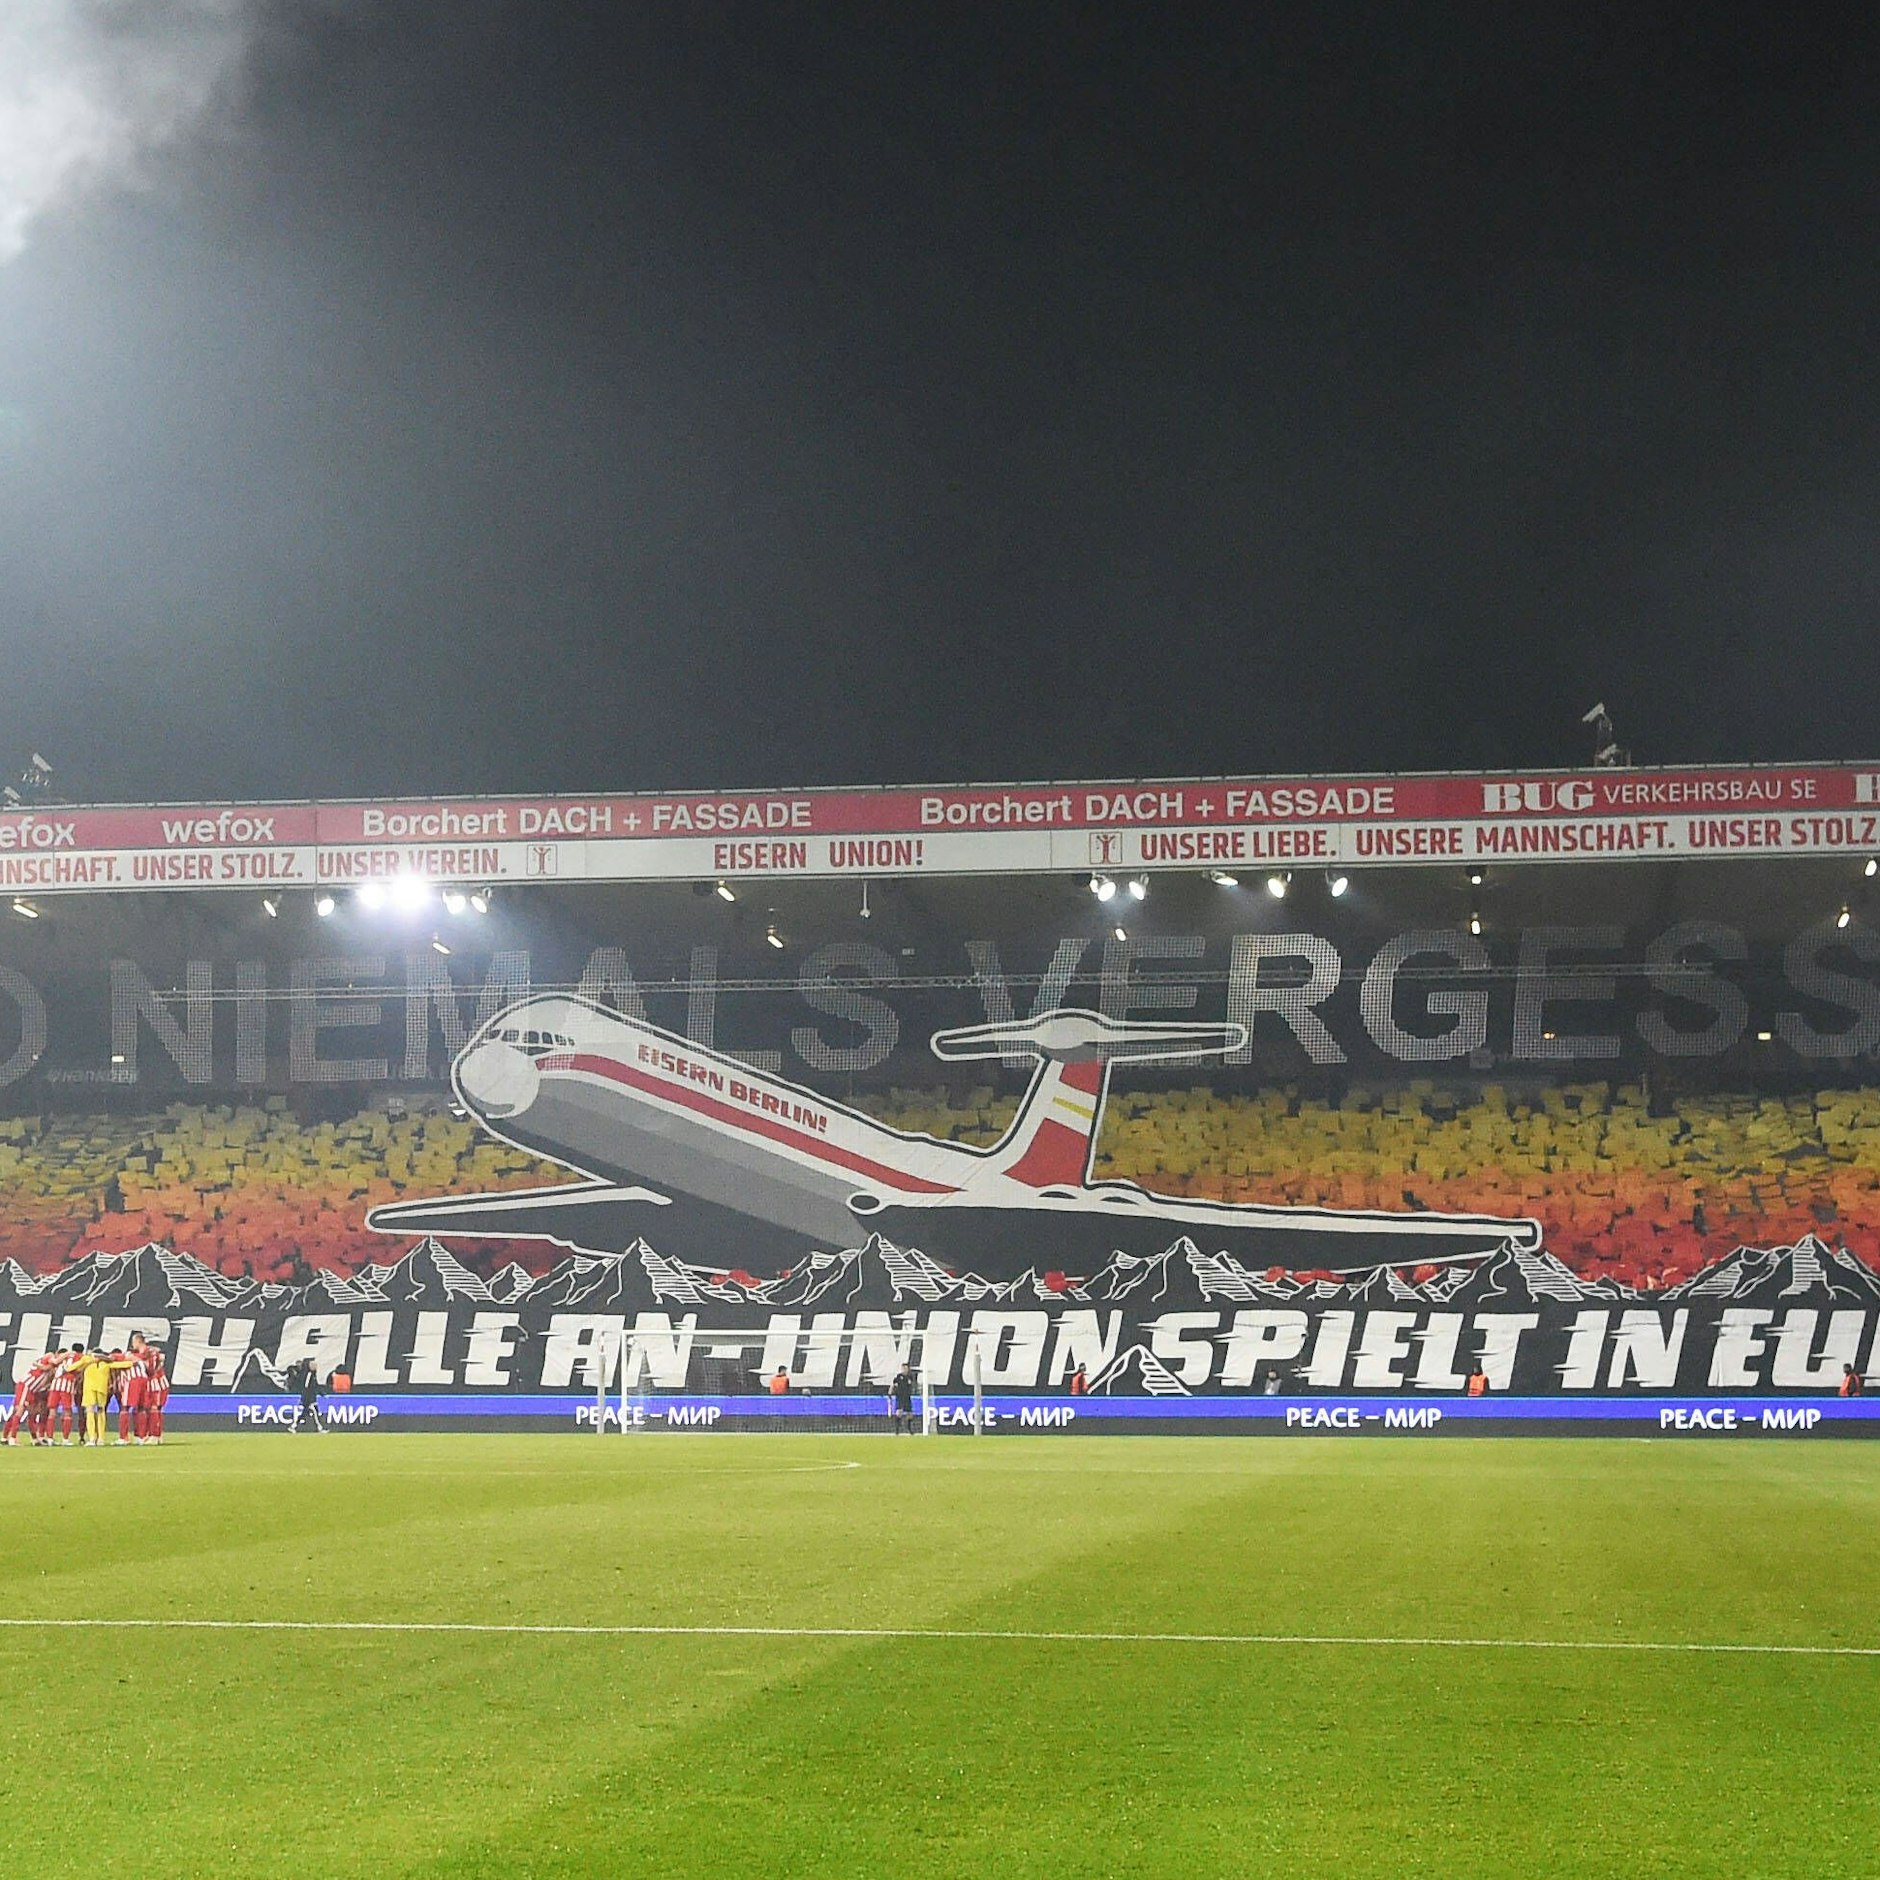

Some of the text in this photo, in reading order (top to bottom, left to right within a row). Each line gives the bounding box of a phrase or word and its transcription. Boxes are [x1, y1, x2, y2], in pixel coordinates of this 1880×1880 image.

[921, 796, 1072, 825] Borchert
[1085, 792, 1182, 821] DACH
[1226, 787, 1395, 817] FASSADE
[1481, 779, 1817, 813] BUG VERKEHRSBAU SE
[162, 811, 274, 843] wefox
[363, 808, 507, 837] Borchert
[519, 806, 611, 834] DACH
[652, 801, 813, 830] FASSADE
[714, 839, 923, 869] EISERN UNION!
[1140, 816, 1880, 860] UNSERE LIEBE. UNSERE MANNSCHAFT. UNSER STOLZ
[0, 848, 507, 885] NSCHAFT. UNSER STOLZ. UNSER VEREIN.
[638, 1044, 827, 1134] EISERN BERLIN!
[275, 1310, 520, 1386] ALLE
[1138, 1308, 1539, 1390] SPIELT
[1555, 1308, 1689, 1389] IN
[1709, 1308, 1880, 1388] EU
[238, 1404, 379, 1424] PEACE МИР
[575, 1406, 646, 1425] PEACE
[667, 1406, 721, 1425] МИР
[1020, 1407, 1075, 1426] МИР
[1286, 1407, 1361, 1428] PEACE
[1384, 1407, 1442, 1429] МИР
[1660, 1408, 1737, 1429] PEACE
[1762, 1408, 1821, 1430] МИР
